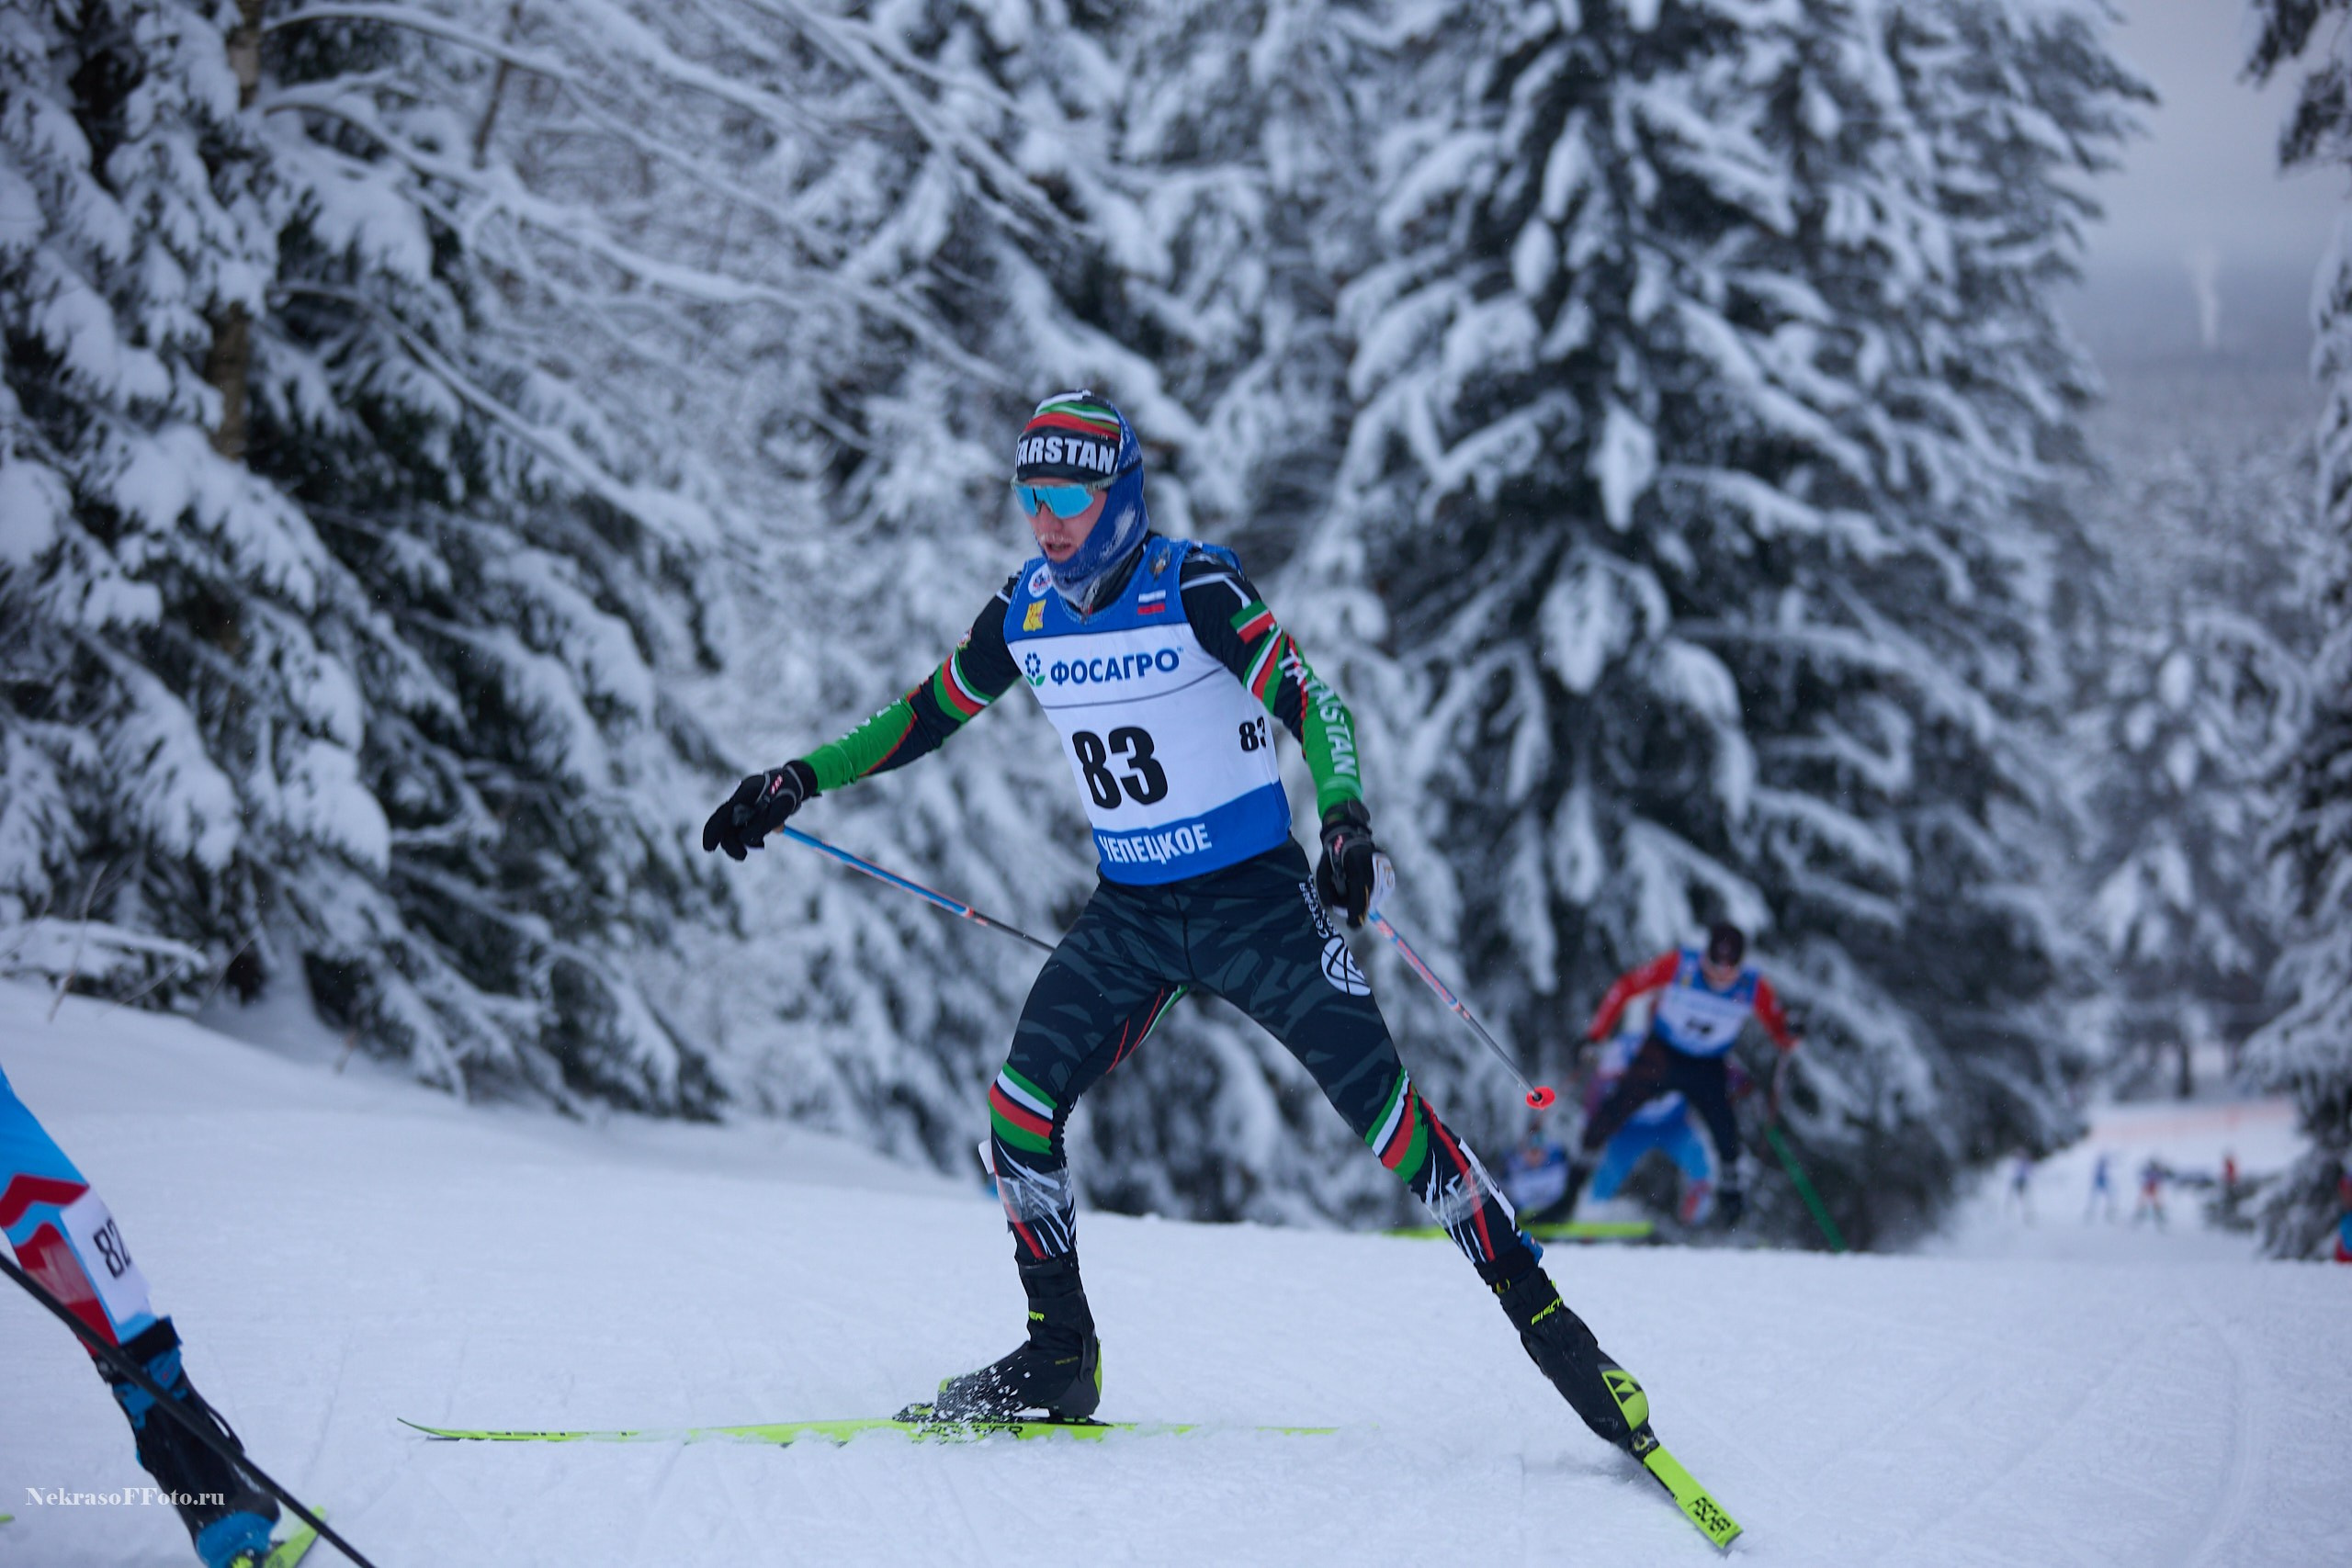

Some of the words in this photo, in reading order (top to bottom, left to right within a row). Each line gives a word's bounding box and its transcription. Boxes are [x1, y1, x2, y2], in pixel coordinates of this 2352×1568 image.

[1017, 436, 1115, 475] ARSTAN
[1050, 648, 1181, 686] ФОСАГРО
[1072, 727, 1168, 809] 83
[1098, 823, 1212, 864] ЧЕПЕЦКОЕ
[94, 1218, 131, 1279] 82
